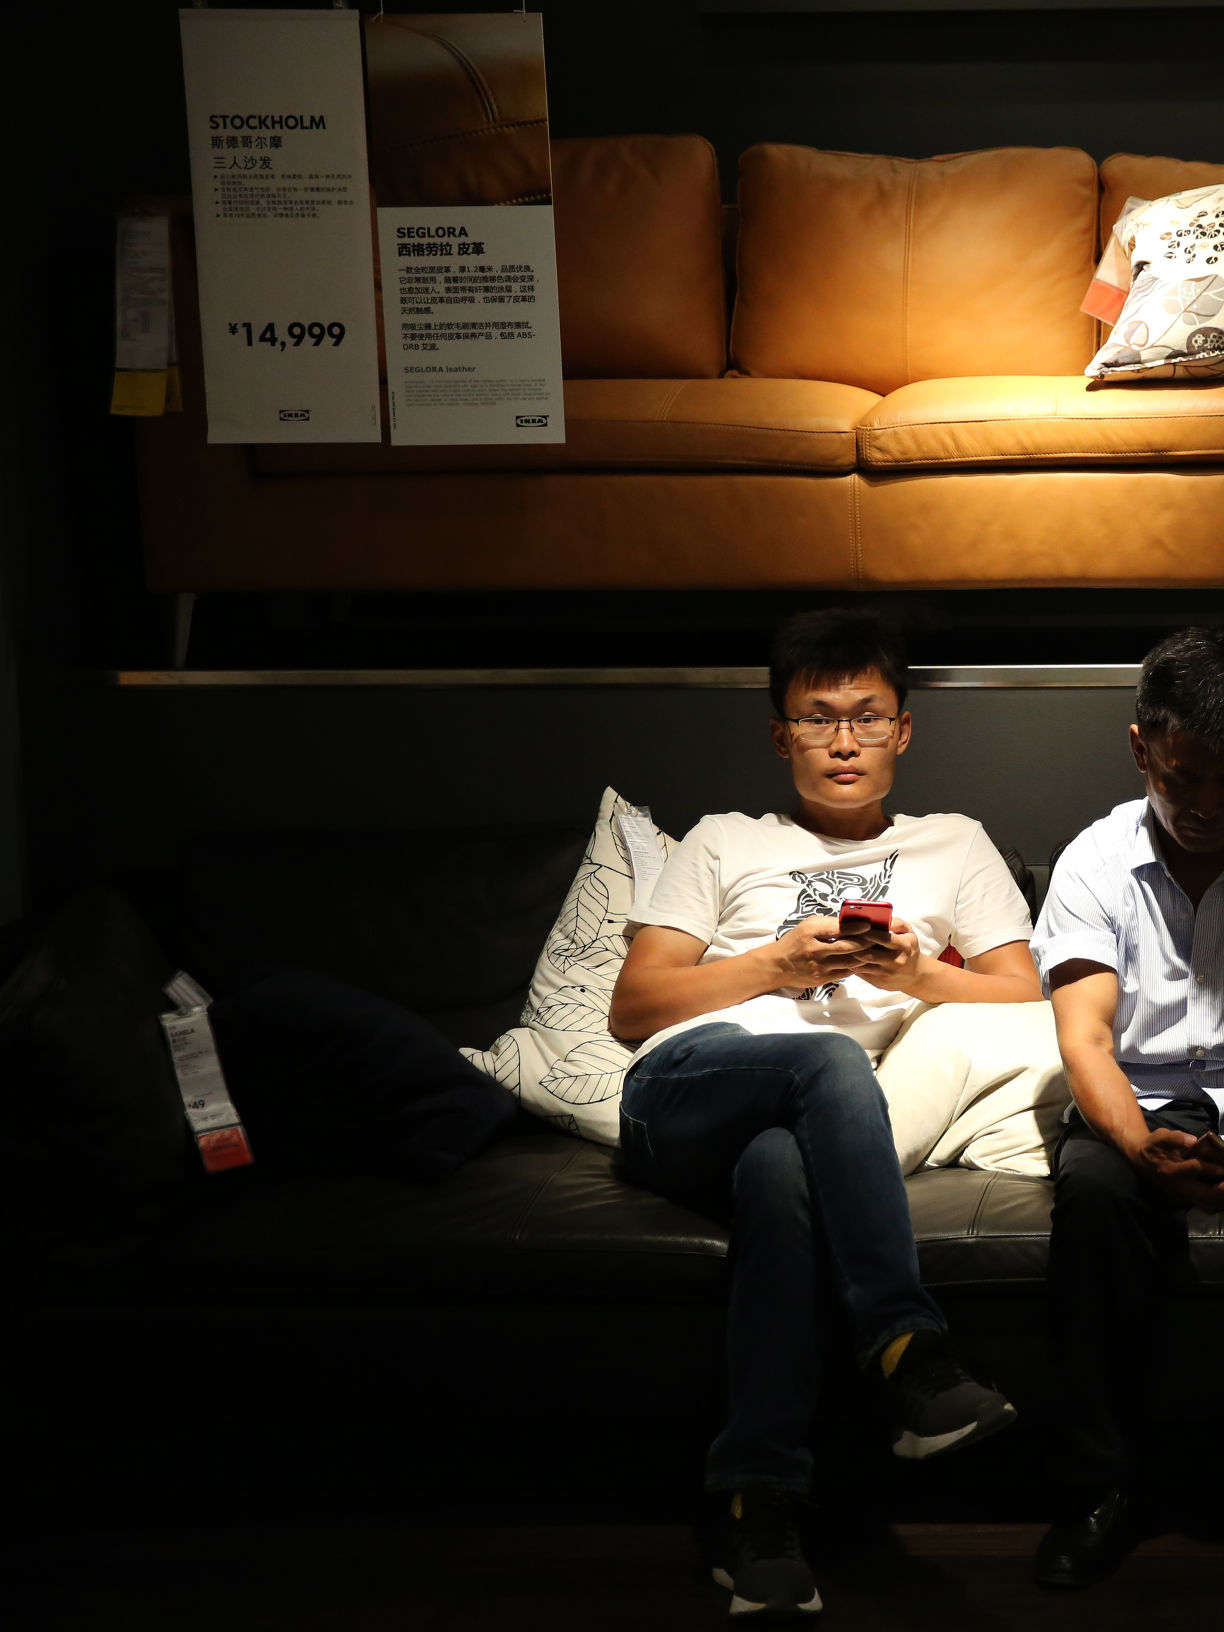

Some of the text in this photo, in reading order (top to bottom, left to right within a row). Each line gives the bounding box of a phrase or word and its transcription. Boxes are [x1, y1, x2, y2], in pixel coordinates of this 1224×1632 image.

[209, 114, 326, 130] STOCKHOLM
[211, 135, 283, 150] 斯德哥尔摩
[213, 155, 273, 171] 三人沙发
[396, 226, 469, 239] SEGLORA
[397, 241, 485, 257] 西格劳拉 皮革
[228, 322, 346, 352] ¥14,999
[517, 331, 536, 340] ABS-
[402, 343, 420, 351] ORB
[404, 365, 477, 374] SEGLORA leather
